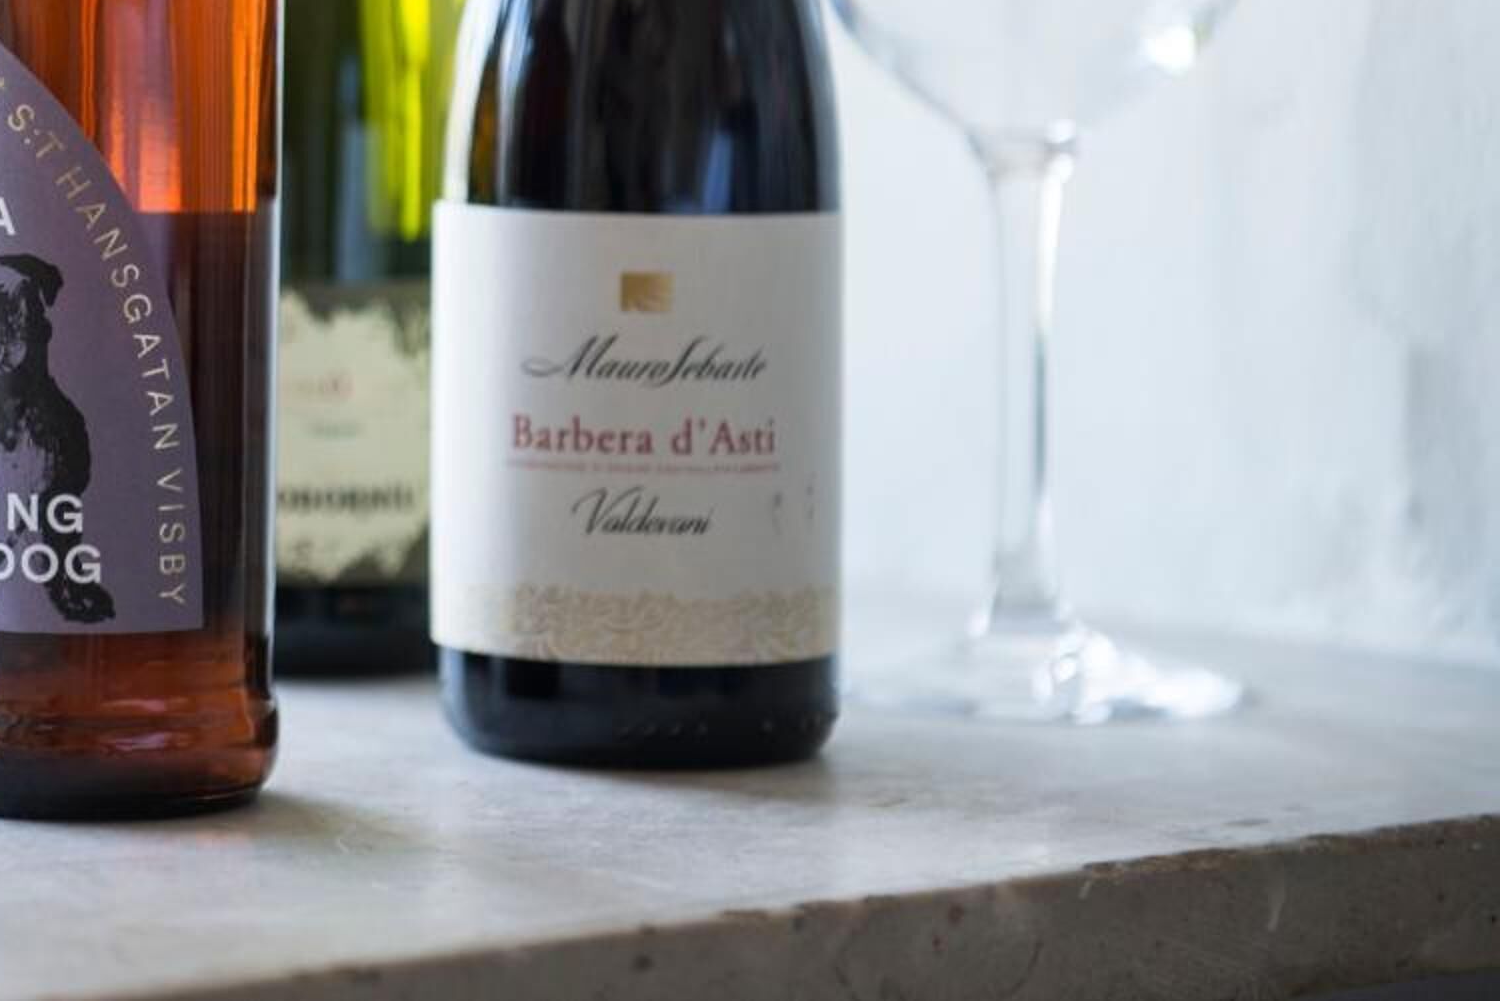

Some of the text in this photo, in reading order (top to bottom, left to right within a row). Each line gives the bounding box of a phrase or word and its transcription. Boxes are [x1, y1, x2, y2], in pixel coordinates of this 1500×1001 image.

[56, 166, 180, 450] HANSGATAN
[157, 469, 185, 604] VISBY
[513, 413, 776, 456] Barbera d'Asti
